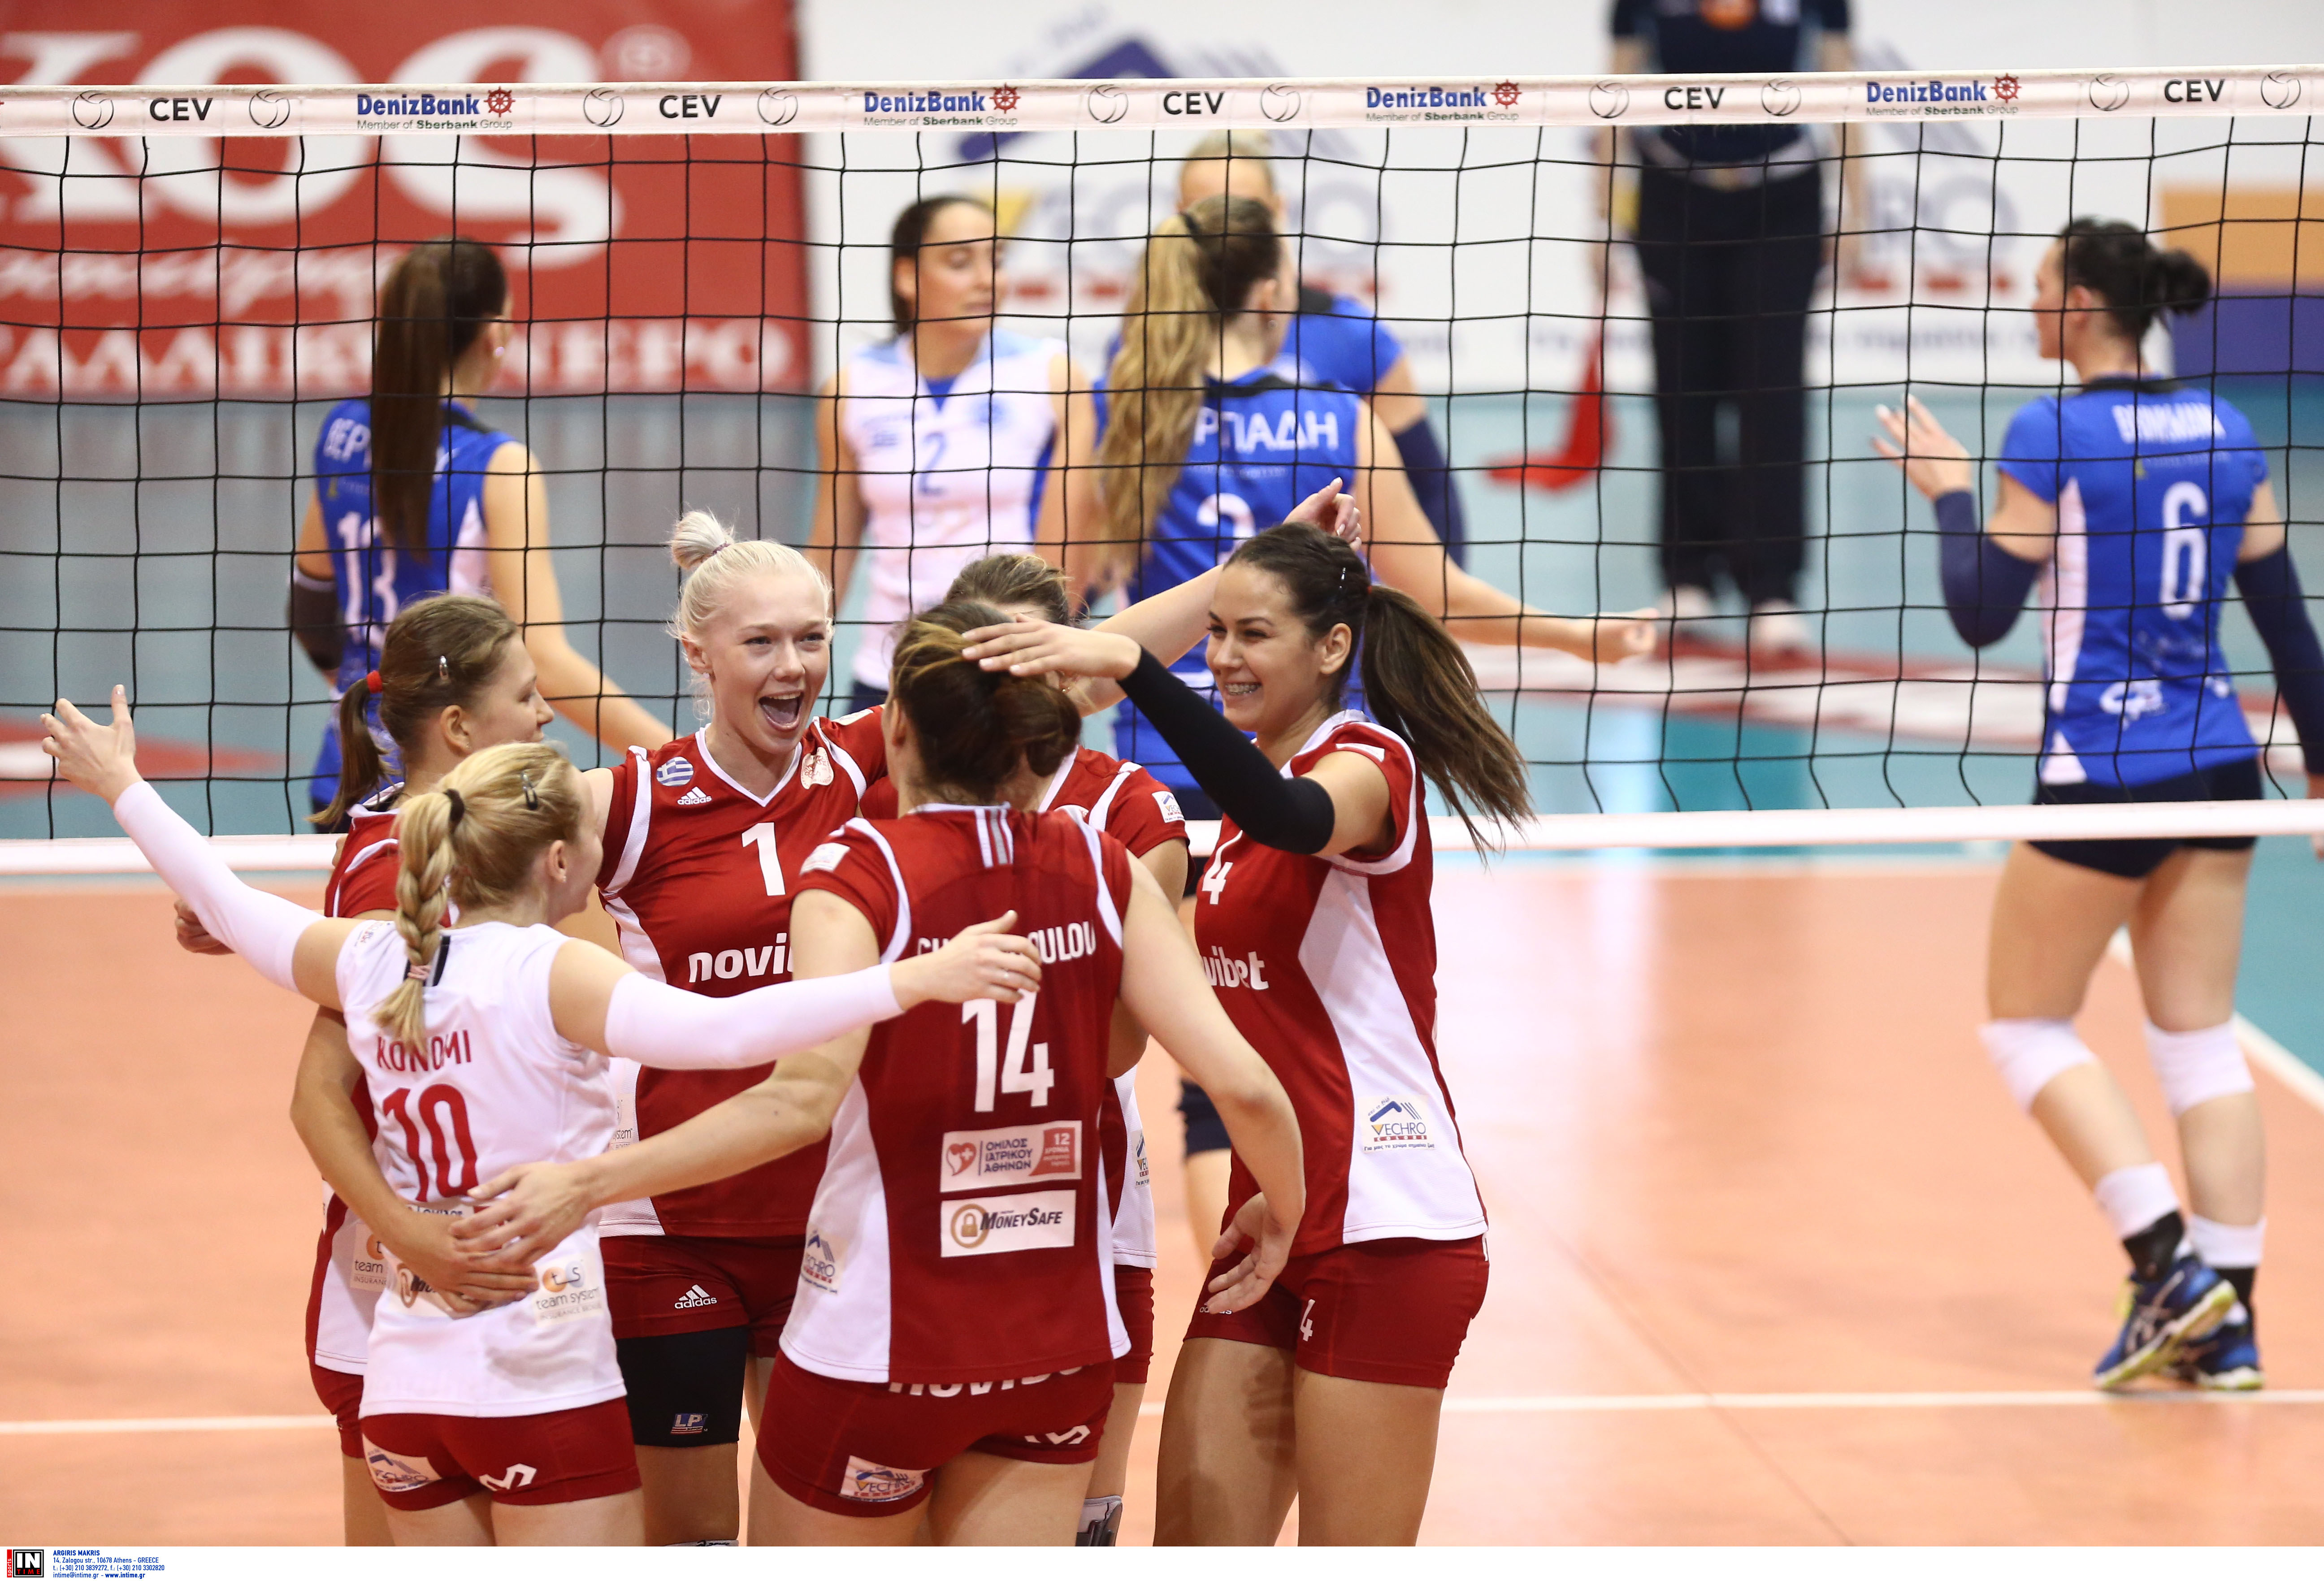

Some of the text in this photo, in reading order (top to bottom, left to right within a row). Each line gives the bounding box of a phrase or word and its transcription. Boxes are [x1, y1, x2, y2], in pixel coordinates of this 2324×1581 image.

[864, 91, 985, 112] DenizBank
[1367, 87, 1487, 108] DenizBank
[1665, 87, 1723, 109] CEV
[1867, 80, 1986, 102] DenizBank
[2165, 81, 2223, 102] CEV
[150, 98, 212, 121] CEV
[357, 94, 480, 115] DenizBank
[660, 95, 721, 118] CEV
[1164, 92, 1223, 114] CEV
[1866, 105, 2018, 116] Member of Sberbank Group
[357, 119, 512, 129] Member of Sberbank Group
[864, 116, 1018, 126] Member of Sberbank Group
[1366, 112, 1518, 121] Member of Sberbank Group
[918, 431, 947, 494] 2
[2160, 481, 2208, 621] 6
[677, 796, 712, 805] adidas
[741, 822, 785, 896] 1
[689, 933, 793, 983] novi
[377, 1030, 471, 1073] KONOMI
[962, 989, 1054, 1113] 14
[1054, 1132, 1070, 1145] 12
[1371, 1122, 1426, 1135] VECHRO
[383, 1083, 479, 1202] 10
[986, 1138, 1028, 1151] ΟΜΙΛΟΣ
[986, 1149, 1032, 1161] ΙΑΤΡΙΚΟΥ
[985, 1160, 1031, 1173] ΑΘΗΝΩΝ
[355, 1260, 383, 1273] team
[536, 1295, 568, 1309] team
[674, 1297, 717, 1309] adidas
[1300, 1299, 1316, 1342] 4
[675, 1414, 702, 1427] LP
